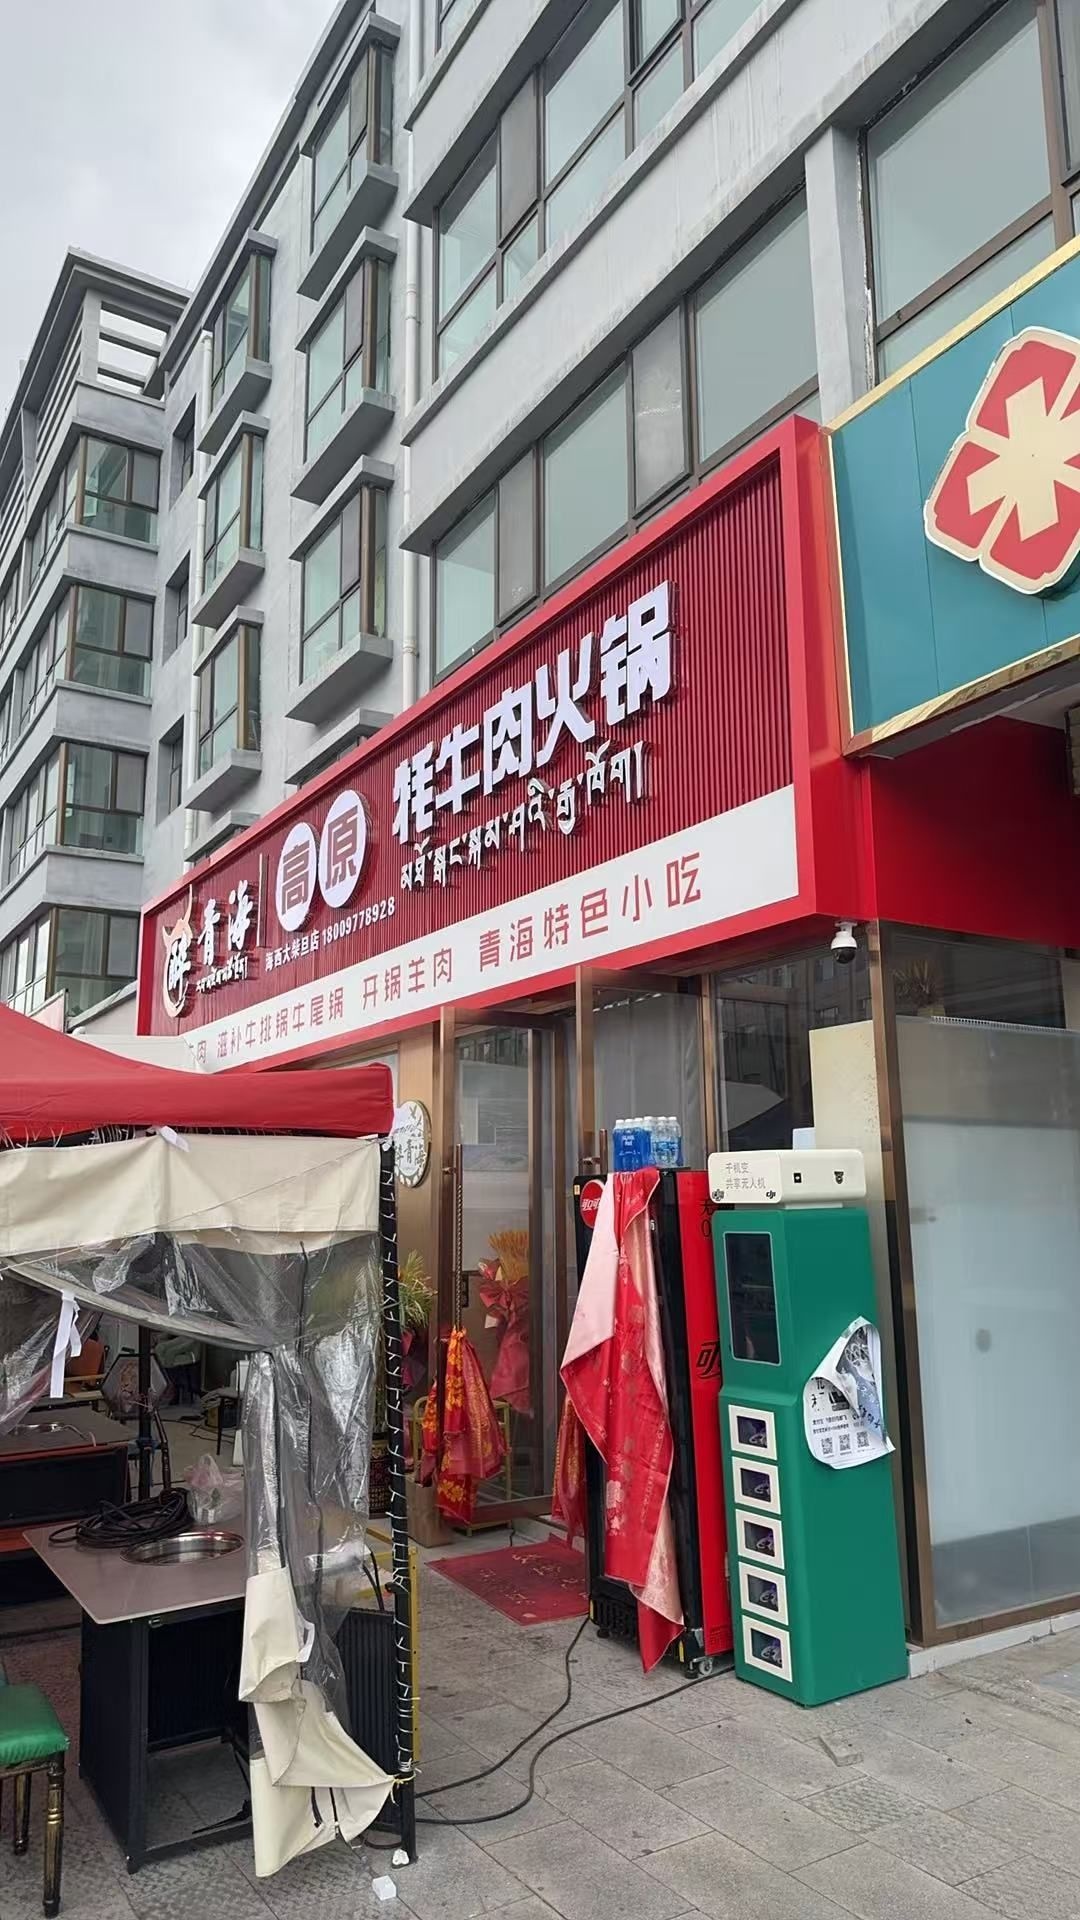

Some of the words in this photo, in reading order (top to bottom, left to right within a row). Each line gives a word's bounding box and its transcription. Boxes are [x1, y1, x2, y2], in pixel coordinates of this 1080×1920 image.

[281, 805, 358, 916] 高原
[392, 580, 671, 845] 牦牛肉火锅
[217, 987, 344, 1059] 滋补牛排锅牛尾锅
[362, 947, 452, 1010] 开锅羊肉
[479, 852, 701, 973] 青海特色小吃
[265, 928, 320, 972] 海西大柴旦店
[322, 897, 396, 945] 18009778928
